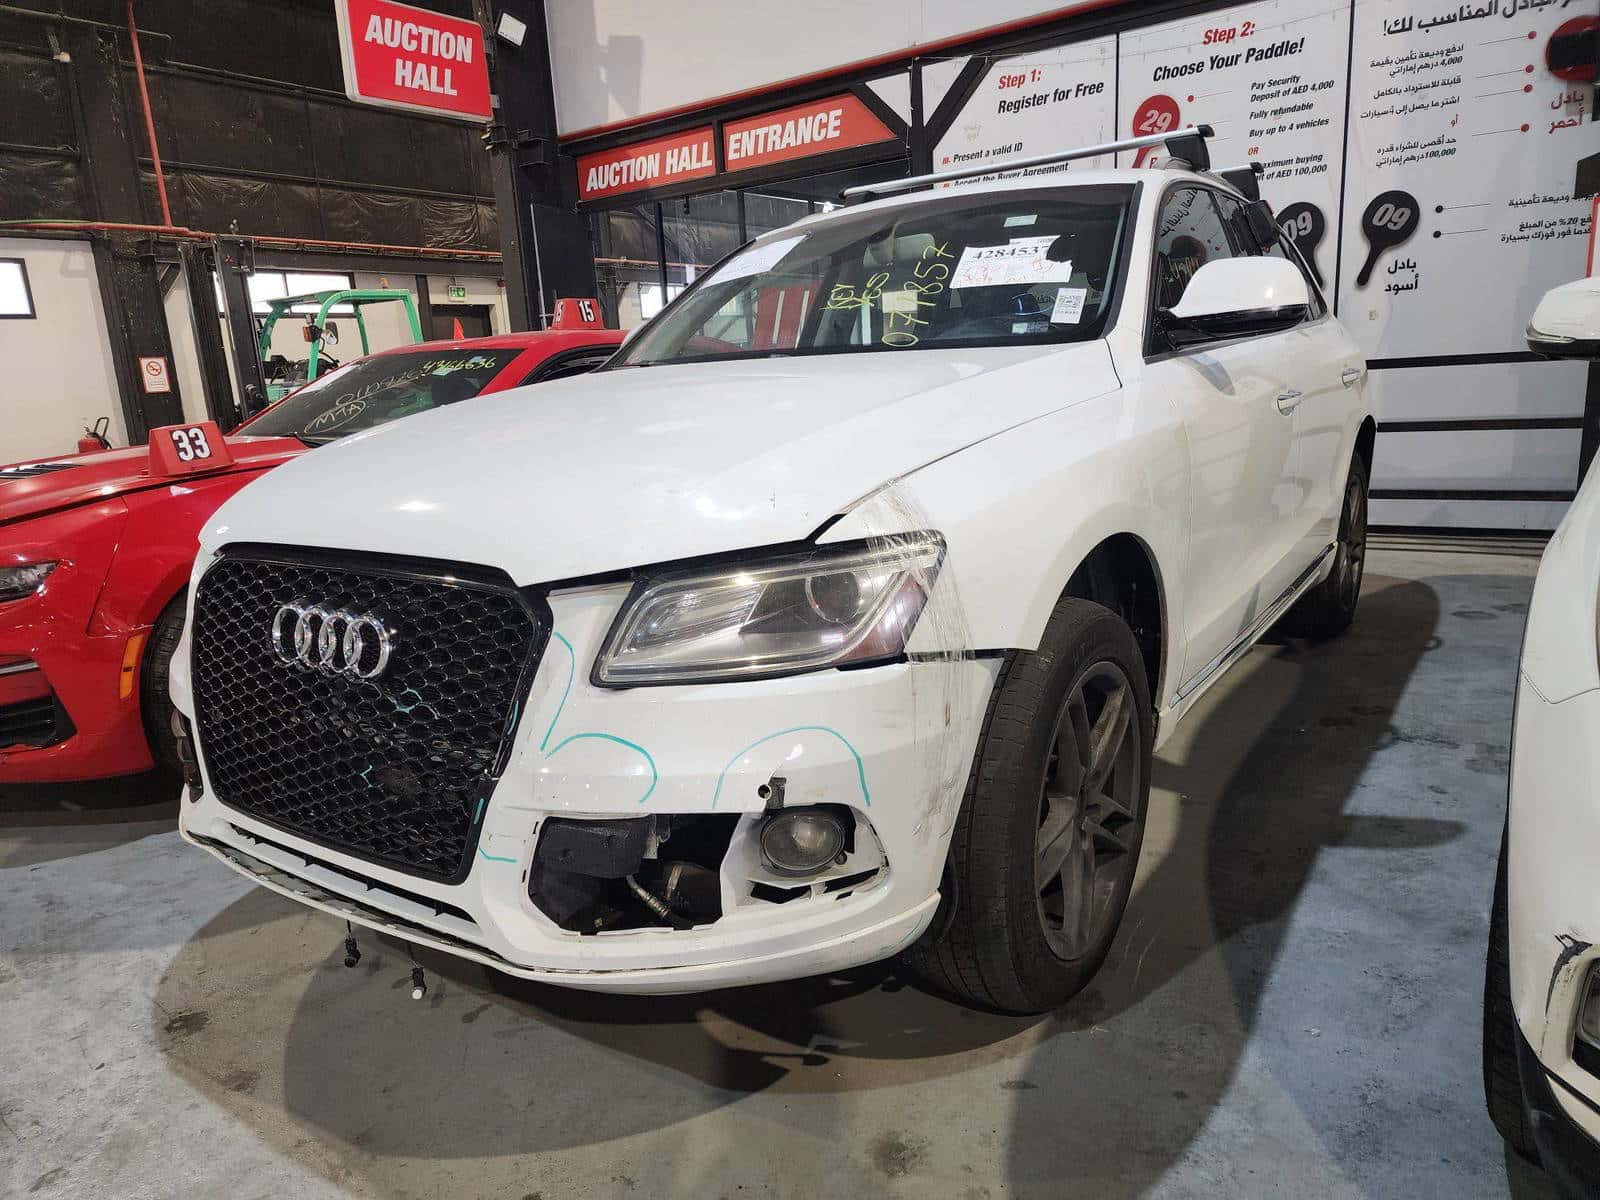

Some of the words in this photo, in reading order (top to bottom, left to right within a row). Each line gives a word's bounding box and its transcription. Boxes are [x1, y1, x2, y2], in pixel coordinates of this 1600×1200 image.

[364, 14, 473, 64] AUCTION
[1202, 26, 1236, 46] Step
[1240, 20, 1256, 38] 2:
[1152, 60, 1205, 83] Choose
[1209, 52, 1242, 72] Your
[1245, 37, 1305, 65] Paddle!
[1369, 55, 1393, 69] بقيمة
[1394, 50, 1417, 65] تأمين
[1419, 48, 1444, 60] وديعة
[1440, 56, 1463, 68] 4,000
[1417, 61, 1439, 72] درهم
[394, 58, 458, 97] HALL
[998, 71, 1026, 90] Step
[1030, 68, 1042, 83] 1:
[1250, 82, 1265, 92] Pay
[1267, 75, 1301, 88] Security
[1404, 80, 1440, 94] للاسترداد
[1440, 75, 1462, 87] قابلة
[998, 92, 1050, 115] Register
[1053, 86, 1073, 105] for
[1074, 80, 1104, 99] Free
[1250, 90, 1280, 103] Deposit
[1282, 88, 1290, 97] of
[1292, 84, 1308, 95] AED
[1310, 80, 1335, 92] 4,000
[1373, 87, 1402, 100] بالكامل
[1551, 90, 1584, 110] بادل
[1249, 110, 1269, 121] Fully
[1270, 102, 1314, 116] refundable
[1409, 103, 1430, 113] يصل
[1138, 109, 1172, 133] 29
[1249, 129, 1264, 138] Buy
[1266, 127, 1276, 136] up
[1278, 125, 1286, 133] to
[1288, 123, 1294, 131] 4
[1296, 118, 1330, 130] vehicles
[1548, 107, 1584, 134] أحمر
[727, 108, 843, 161] ENTRANCE
[952, 150, 983, 163] Present
[984, 150, 990, 158] a
[992, 143, 1012, 156] valid
[1013, 142, 1023, 152] ID
[1248, 146, 1259, 156] OR
[586, 153, 660, 192] AUCTION
[665, 141, 713, 176] HALL
[1263, 157, 1294, 169] aximum
[1295, 154, 1323, 165] buying
[1266, 171, 1275, 180] of
[1276, 168, 1292, 179] AED
[1294, 163, 1328, 176] 100,000
[1542, 193, 1570, 205] وديعة
[1283, 210, 1313, 241] 09
[1371, 203, 1411, 231] 09
[1544, 220, 1557, 229] من
[1387, 258, 1417, 275] بادل
[1384, 273, 1419, 296] أسود
[578, 300, 595, 323] 15
[172, 427, 211, 461] 33
